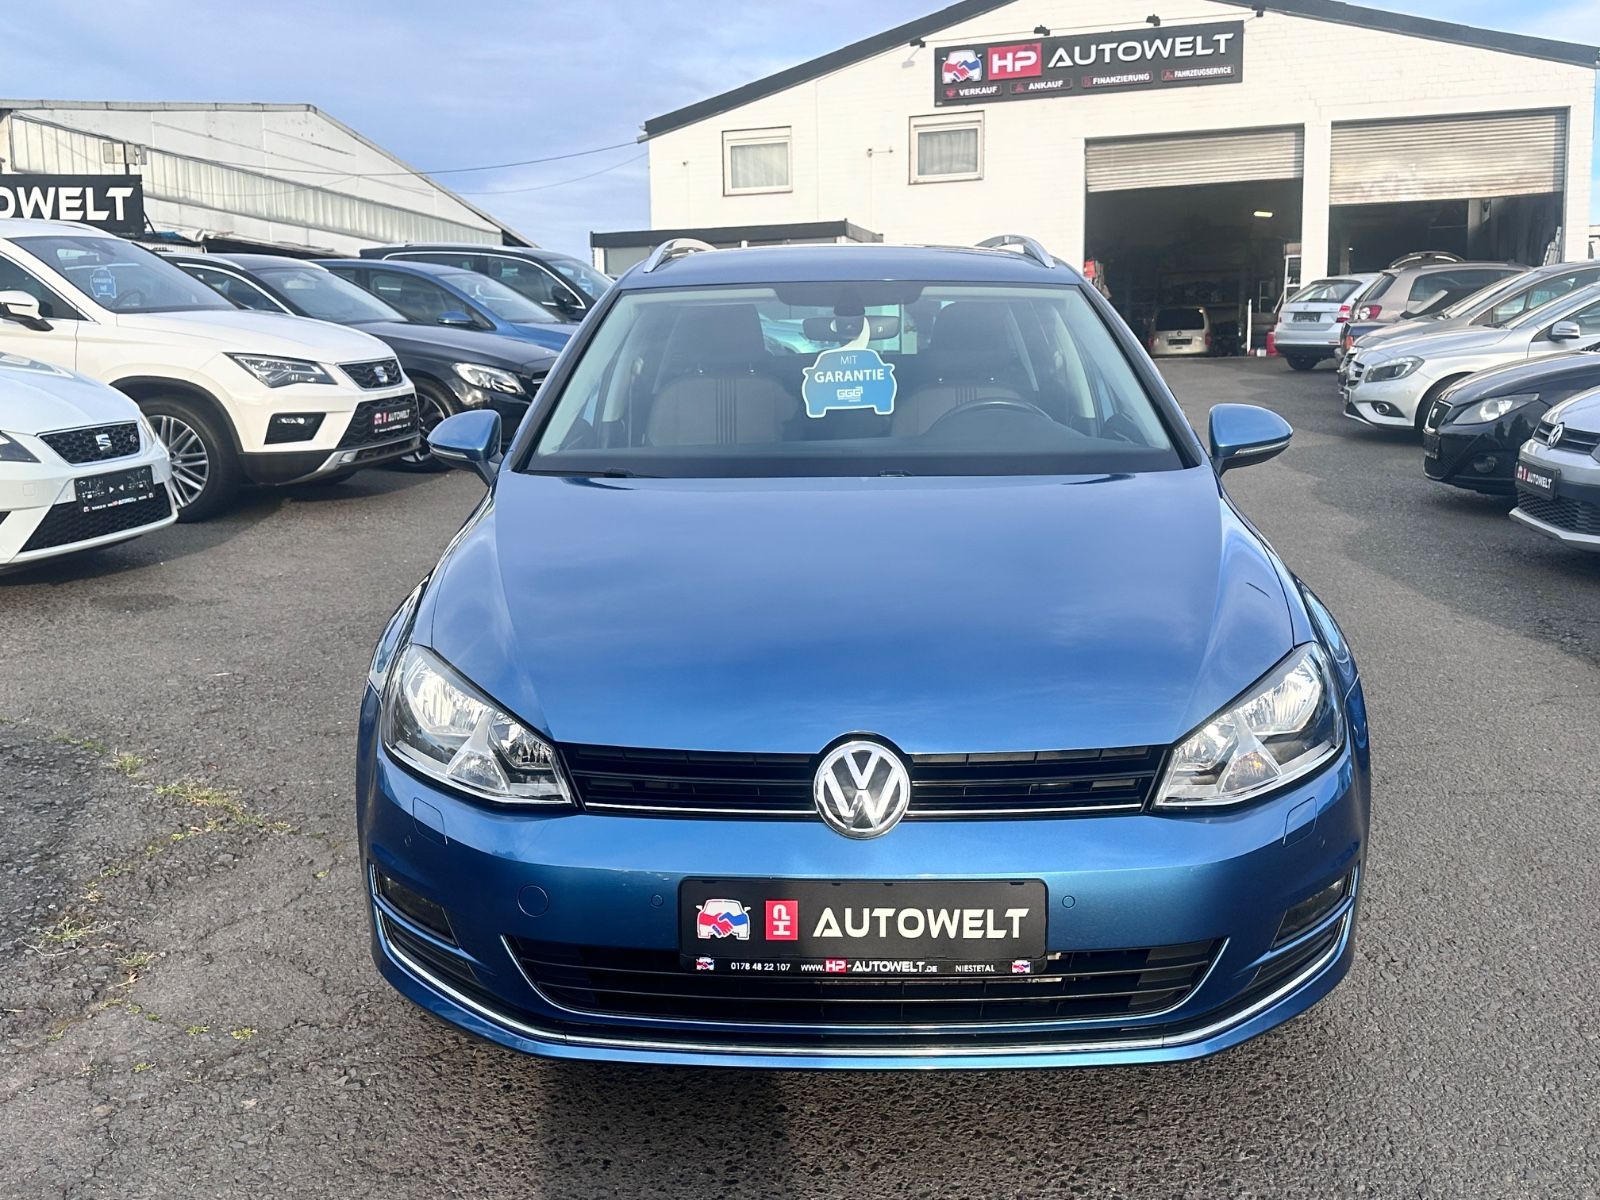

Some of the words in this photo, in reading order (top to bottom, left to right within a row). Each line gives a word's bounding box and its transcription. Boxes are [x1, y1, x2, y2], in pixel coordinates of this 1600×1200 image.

[992, 51, 1037, 74] HP
[1048, 33, 1234, 68] AUTOWELT
[1174, 66, 1232, 78] FAHRZEUGSERVICE
[1093, 73, 1150, 85] FINANZIERUNG
[1028, 80, 1063, 90] ANKAUF
[959, 86, 998, 96] VERKAUF
[840, 355, 857, 365] MIT
[814, 368, 885, 383] GARANTIE
[812, 907, 1030, 939] AUTOWELT
[730, 962, 750, 970] 0178
[752, 962, 762, 970] 48
[764, 963, 774, 971] 22
[776, 963, 791, 971] 107
[955, 964, 995, 972] NIESTETAL
